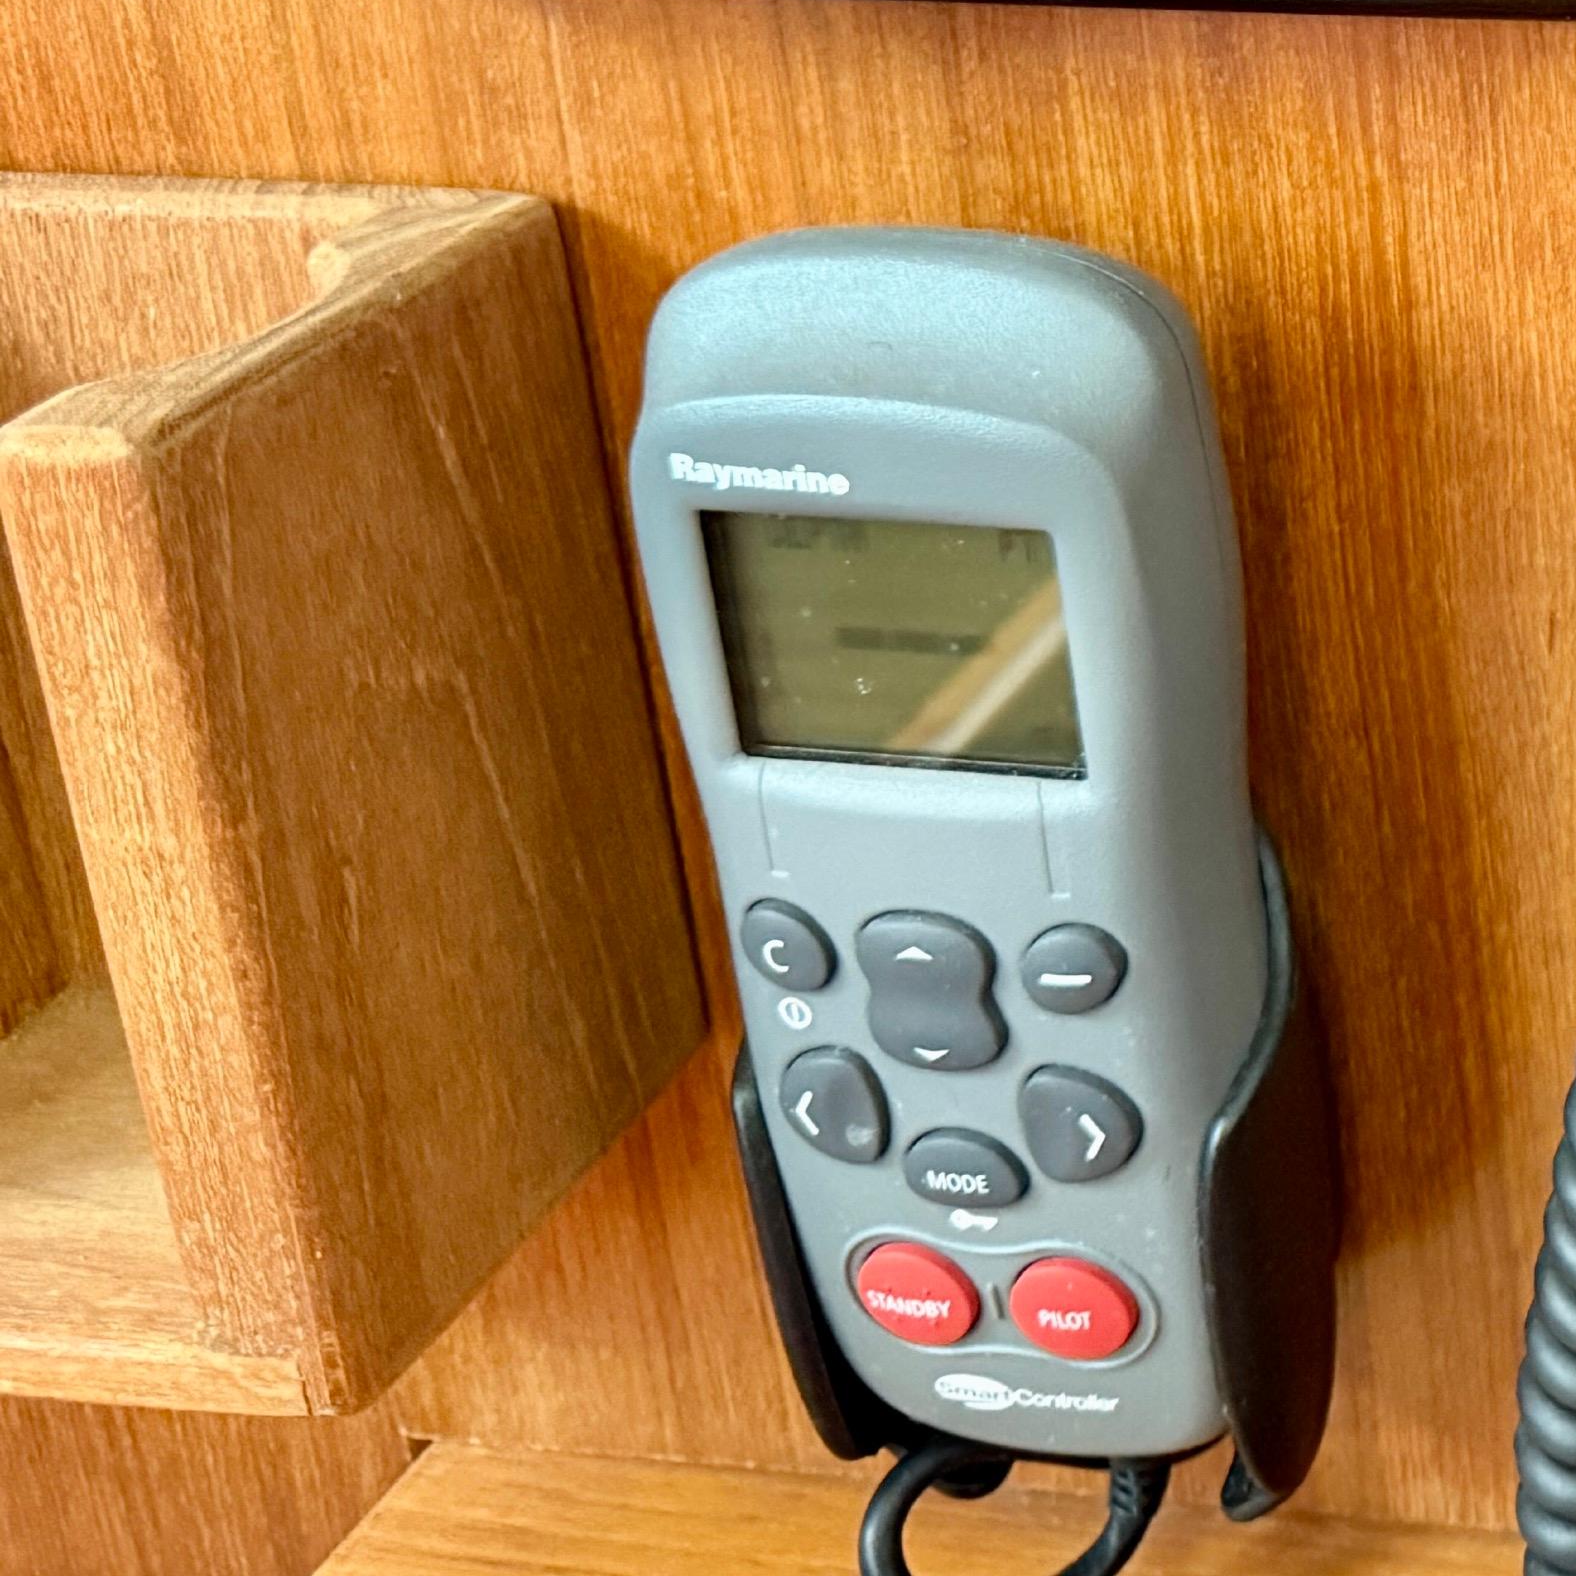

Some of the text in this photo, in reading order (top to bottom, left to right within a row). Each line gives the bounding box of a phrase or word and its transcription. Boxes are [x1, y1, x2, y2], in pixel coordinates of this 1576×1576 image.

[667, 453, 849, 495] Raymarine
[928, 1171, 989, 1194] MODE
[867, 1290, 950, 1318] STANDBY
[1038, 1309, 1091, 1330] PILOT
